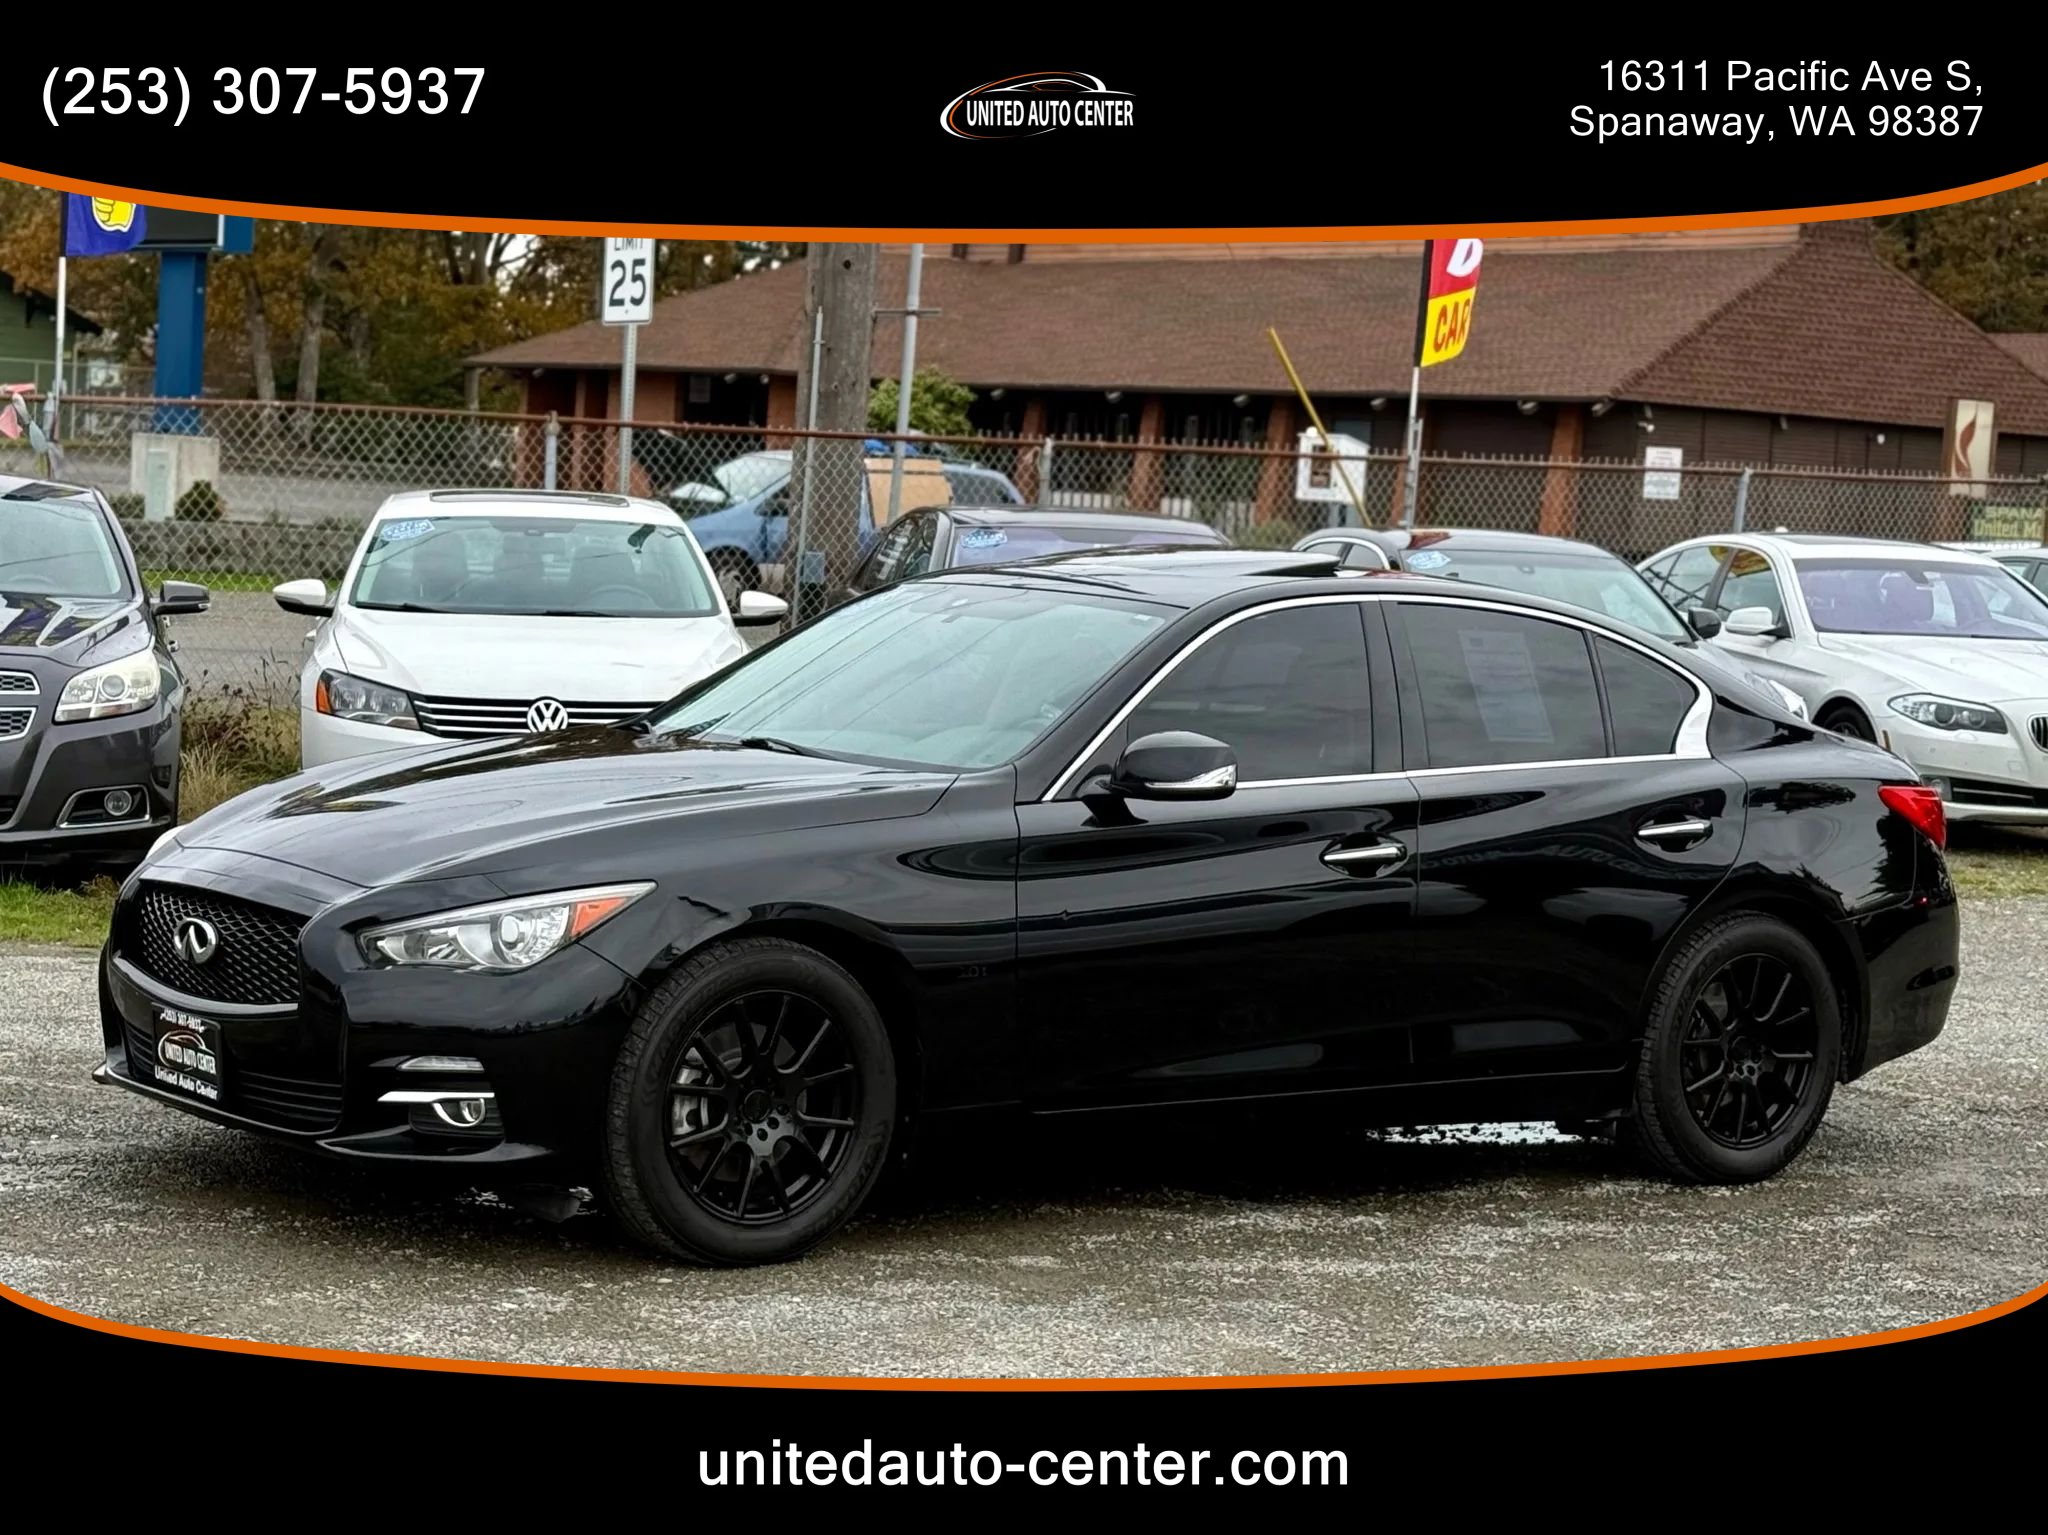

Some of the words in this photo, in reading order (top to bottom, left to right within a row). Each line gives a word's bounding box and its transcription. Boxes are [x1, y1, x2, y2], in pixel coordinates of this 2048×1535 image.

[609, 258, 646, 307] 25
[178, 1074, 195, 1092] Auto
[196, 1080, 217, 1100] Center
